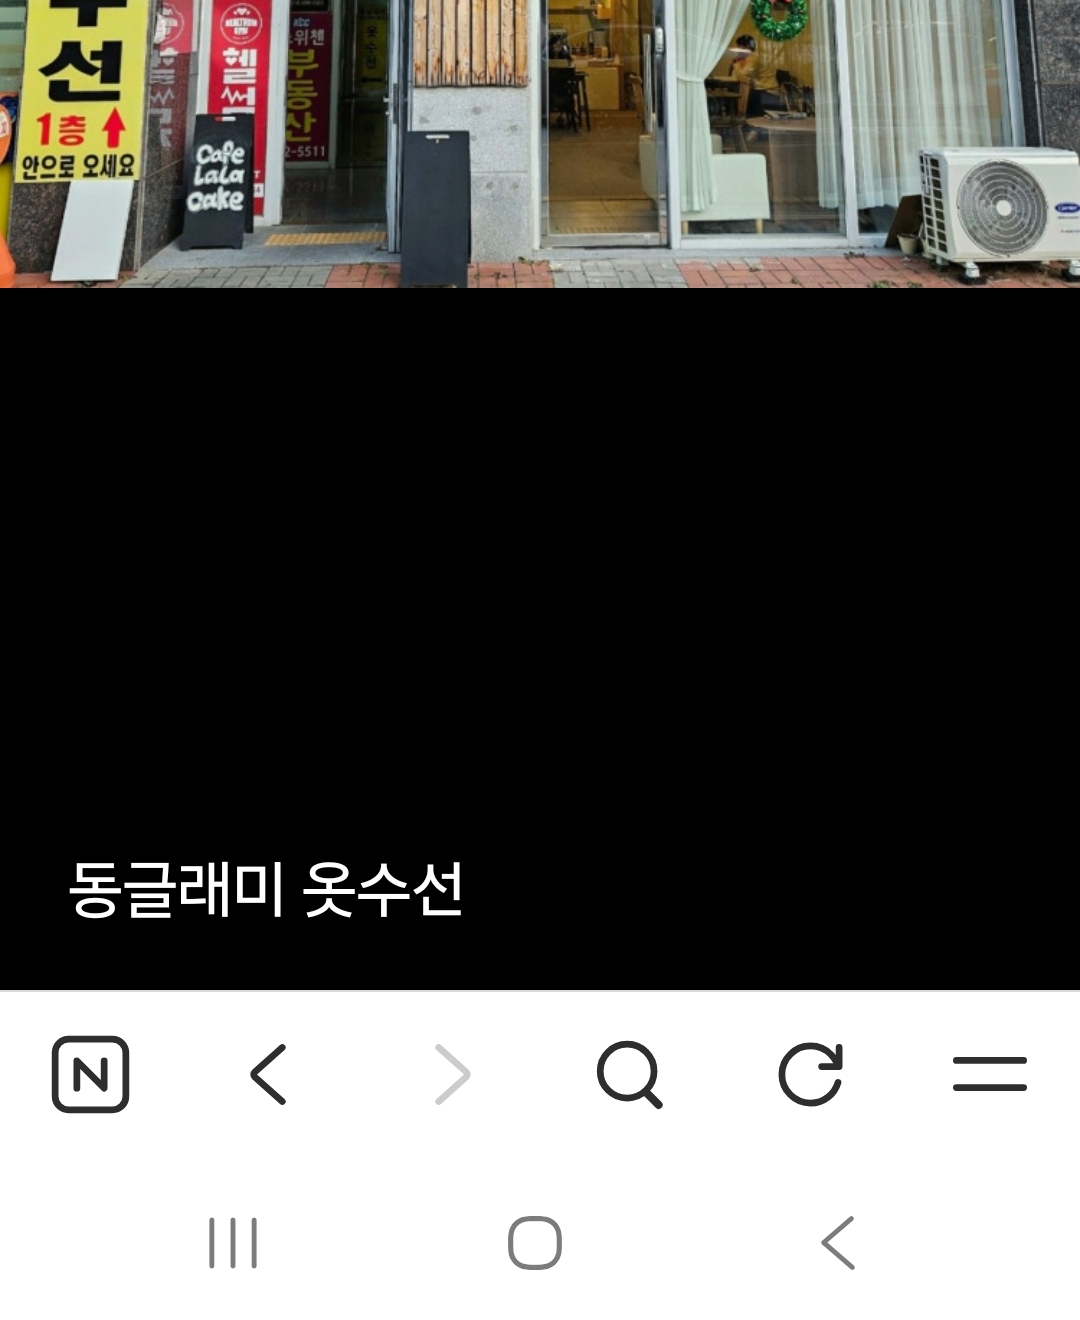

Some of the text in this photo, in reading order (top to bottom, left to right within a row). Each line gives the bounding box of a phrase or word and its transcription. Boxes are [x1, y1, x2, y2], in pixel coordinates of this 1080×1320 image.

[286, 49, 319, 142] 부동산
[37, 112, 86, 147] 1층
[196, 140, 245, 166] Cafe
[22, 154, 135, 180] 안으로 오세요
[194, 165, 245, 186] LaLa
